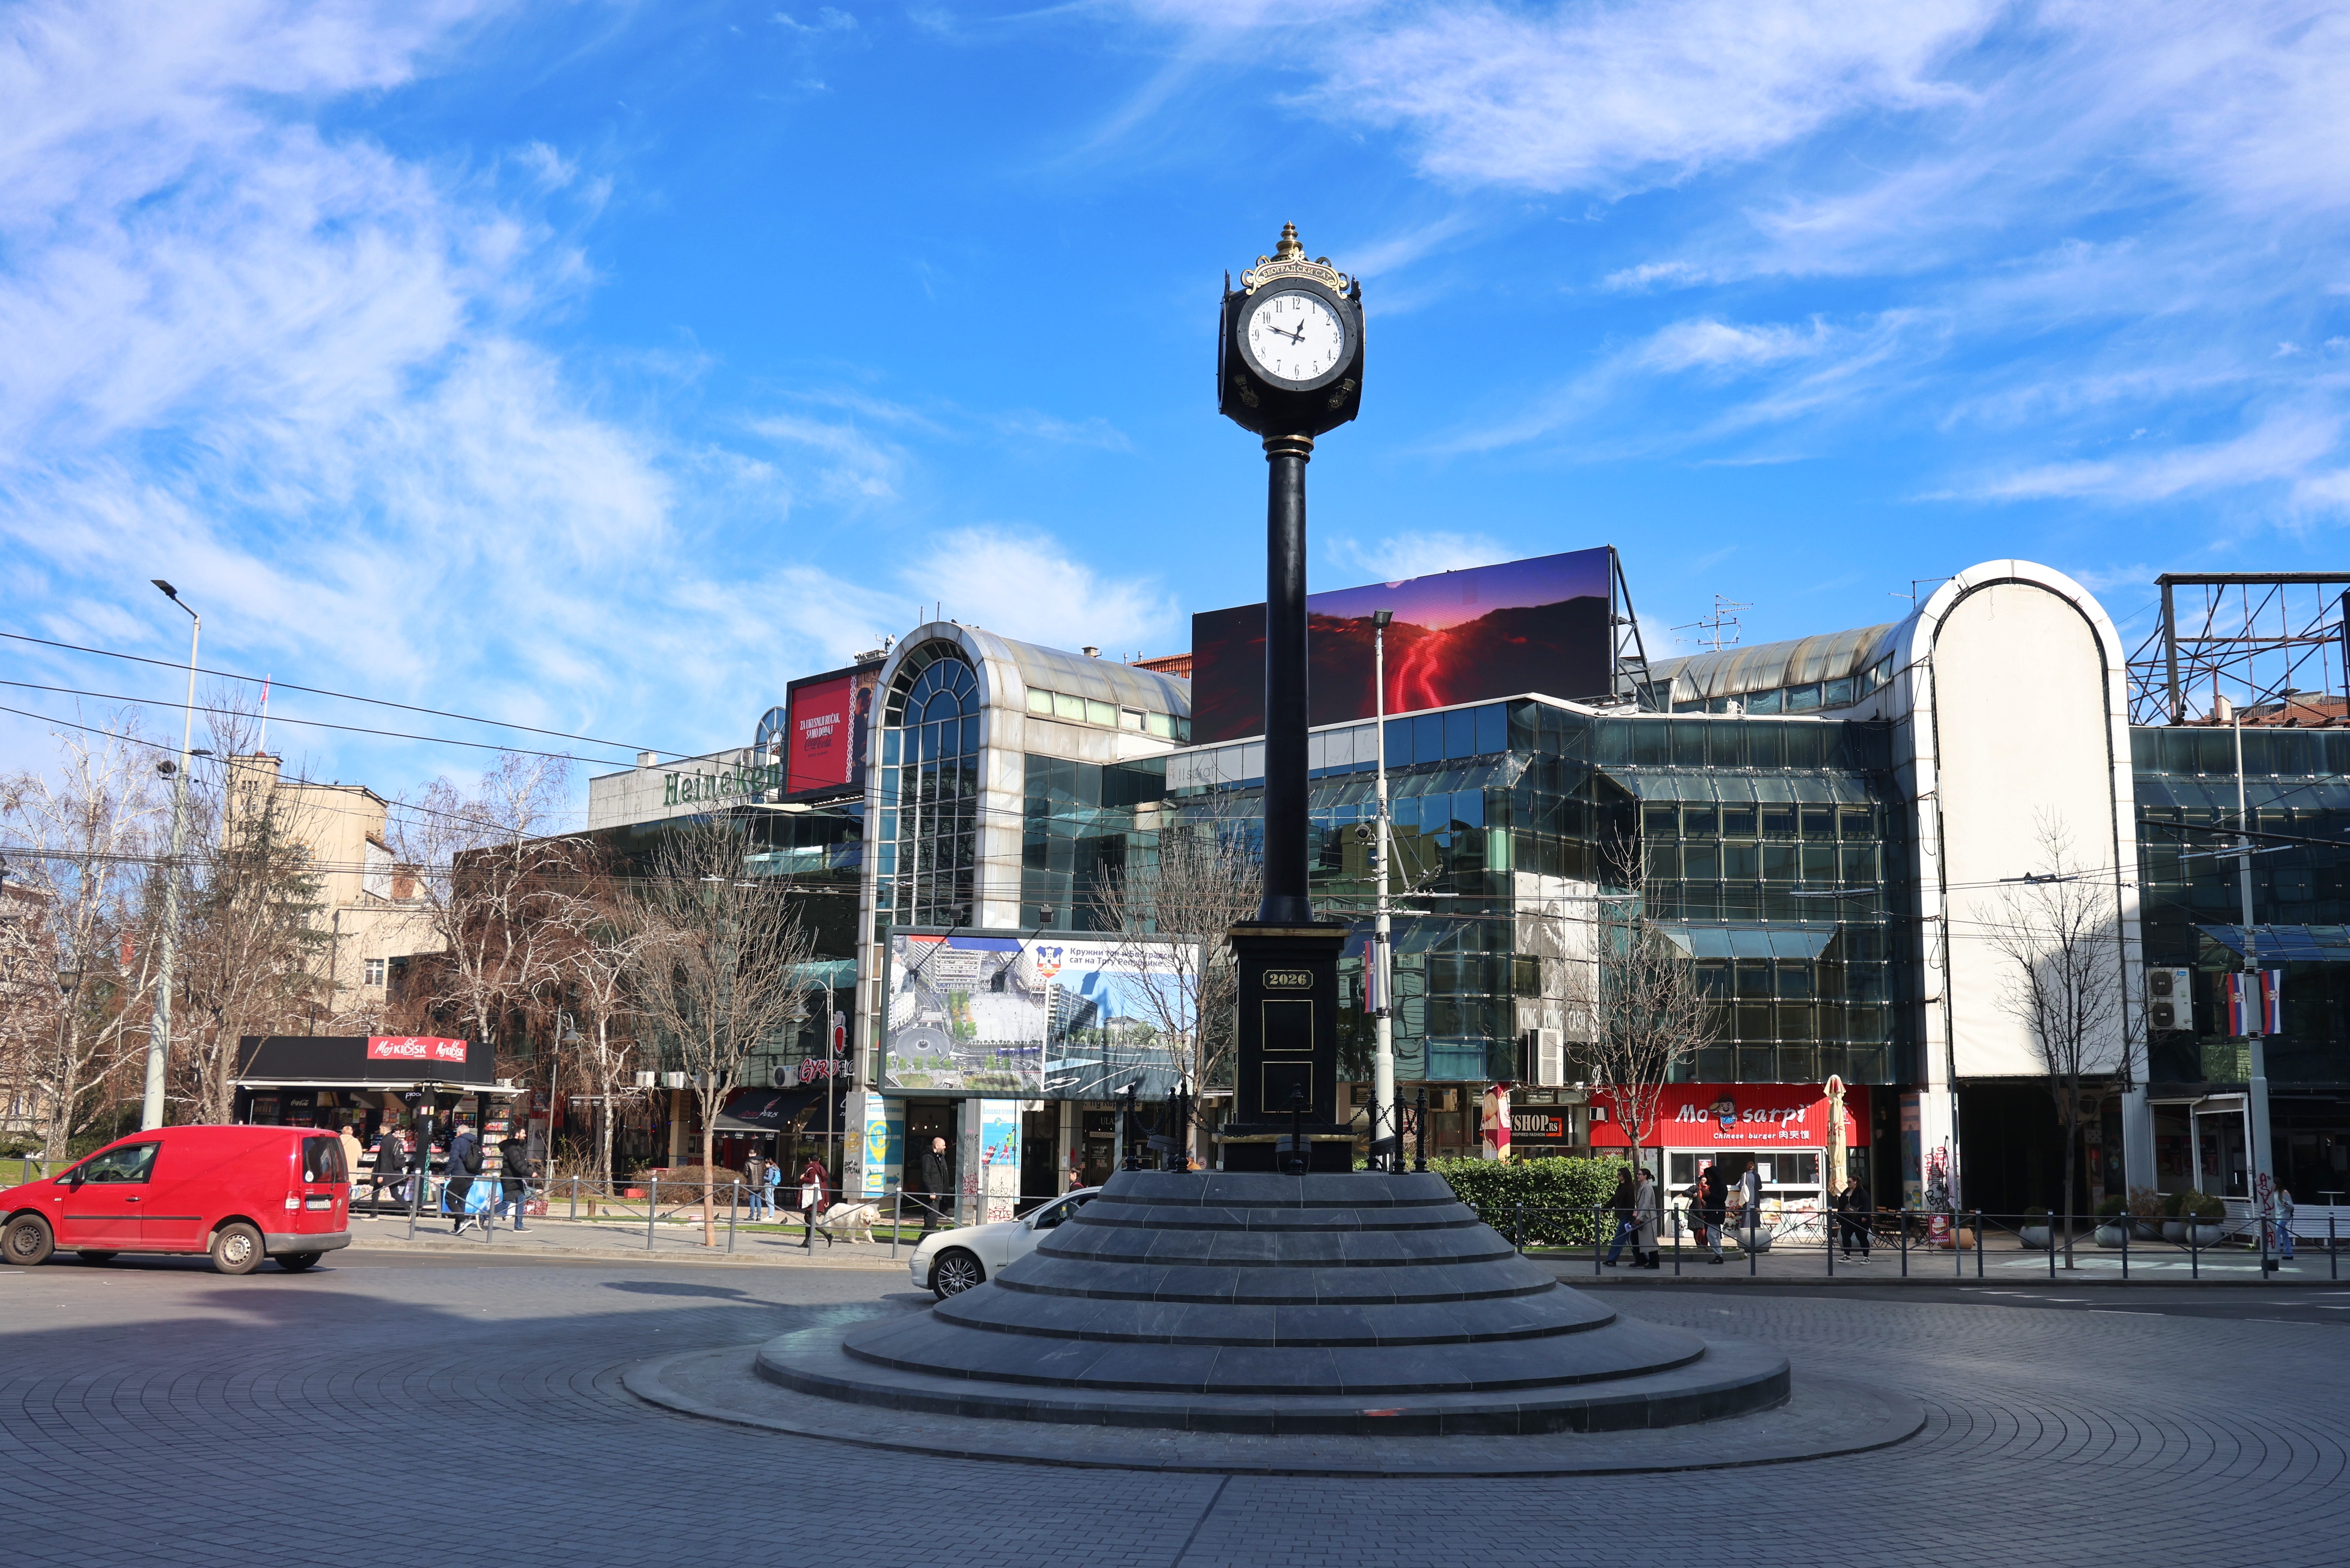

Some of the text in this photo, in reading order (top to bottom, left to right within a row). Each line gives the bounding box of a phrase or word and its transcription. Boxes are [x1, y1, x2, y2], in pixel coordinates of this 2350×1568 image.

[1262, 266, 1331, 280] БЕОГРАДСКИ САТ
[1276, 301, 1283, 313] 11
[1292, 297, 1300, 309] 12
[1312, 301, 1315, 314] 1
[1263, 311, 1271, 324] 10
[1326, 313, 1330, 326] 2
[1255, 329, 1259, 341] 9
[1334, 332, 1338, 344] 3
[1261, 346, 1266, 359] 8
[1327, 349, 1331, 361] 4
[1277, 359, 1281, 372] 7
[1295, 364, 1299, 376] 6
[1313, 360, 1317, 373] 5
[800, 713, 840, 730] ZA UKUSNIJI RUČAK,
[806, 725, 833, 739] SAMO DODAJ
[804, 734, 832, 751] Coca-Cola
[1187, 764, 1214, 782] sprat
[663, 762, 783, 806] Heineken
[1070, 947, 1103, 958] Кружни
[1097, 957, 1115, 967] Тргу
[1270, 974, 1306, 985] 2026
[1520, 1008, 1595, 1033] KING KONG CASI
[375, 1041, 427, 1056] Moj KIOSK
[800, 1058, 854, 1084] GYROPO
[1675, 1104, 1709, 1124] Mo
[1742, 1104, 1806, 1129] sarpi
[1779, 1130, 1810, 1139] 肉夹馍
